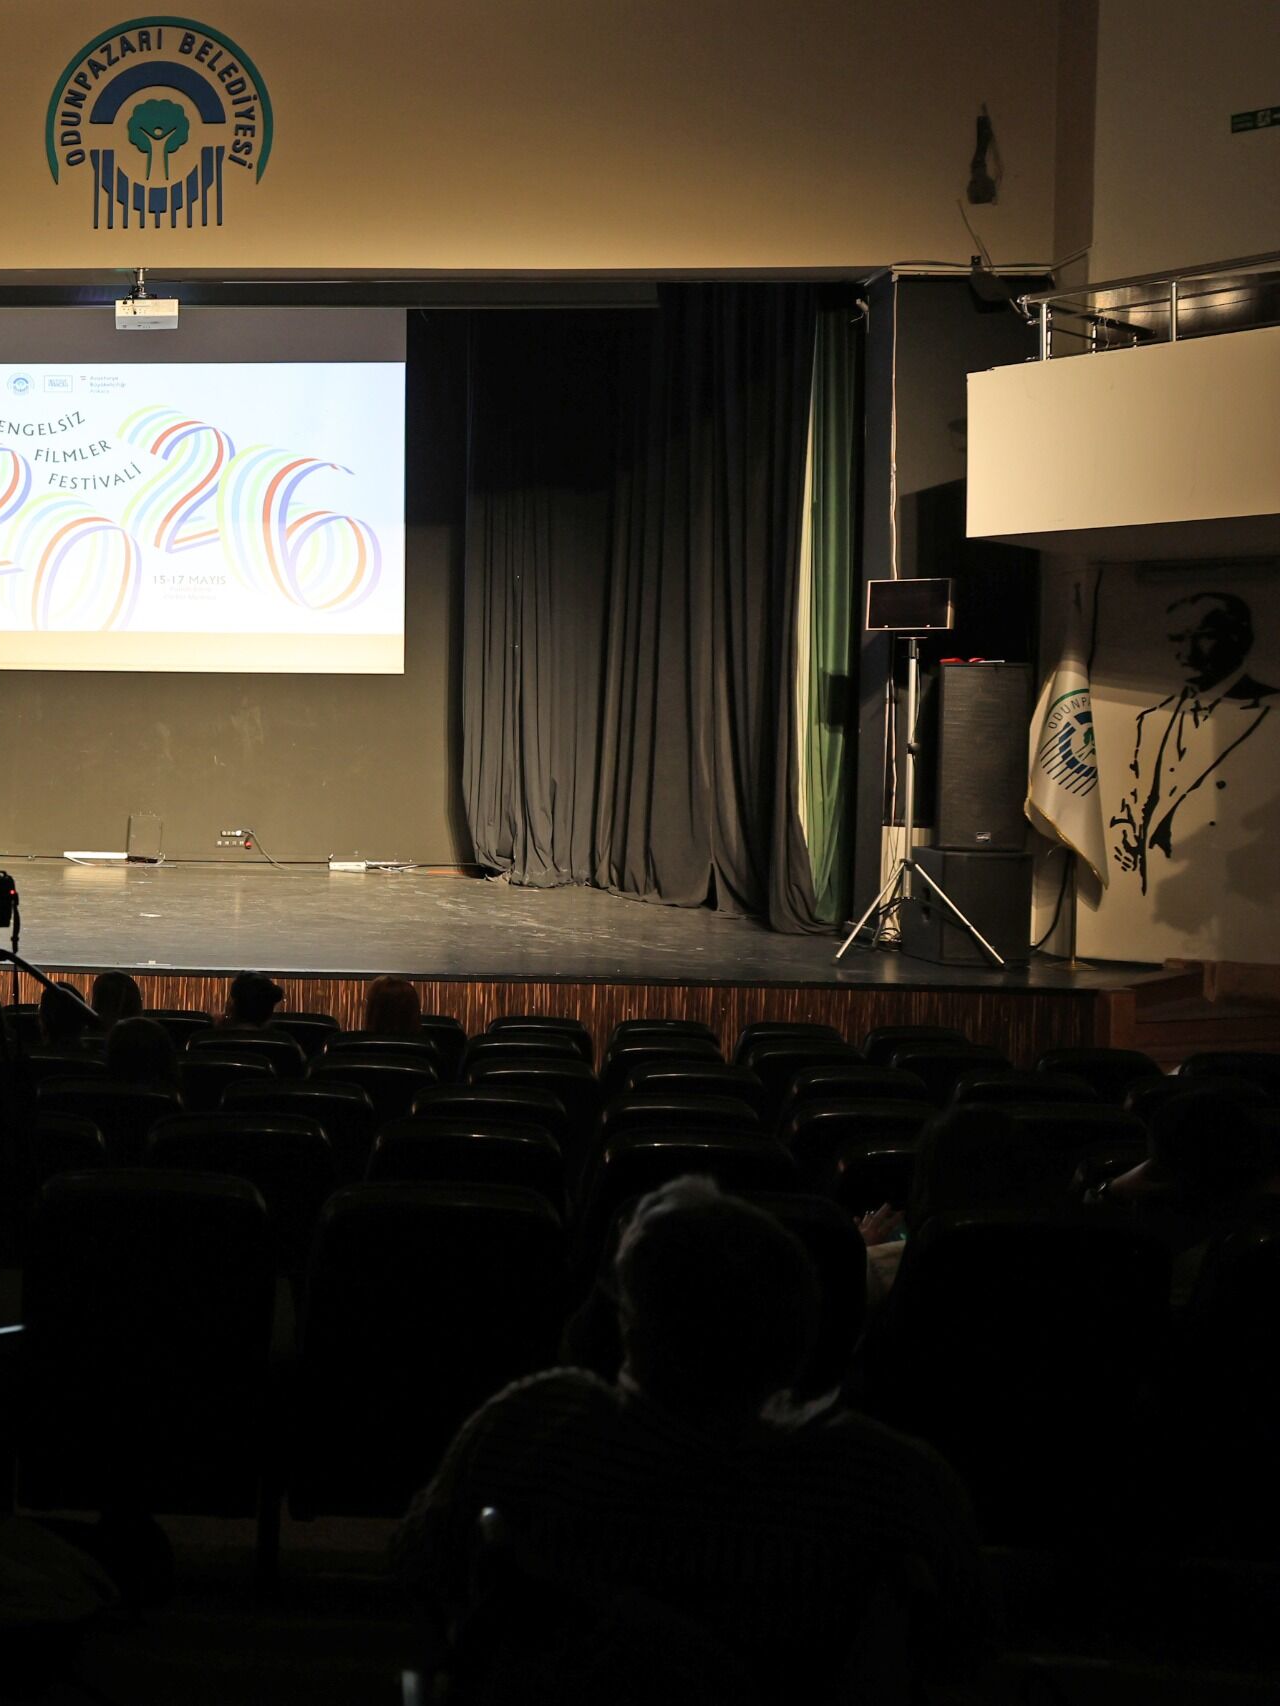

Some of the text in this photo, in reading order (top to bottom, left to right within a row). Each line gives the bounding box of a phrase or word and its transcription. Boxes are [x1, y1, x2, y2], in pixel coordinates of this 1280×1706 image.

[60, 28, 258, 170] ODUNPAZARI BELEDİYESİ
[33, 439, 112, 463] FİLMLER
[47, 461, 142, 491] FESTİVALİ
[153, 575, 227, 585] 15-17 MAYIS
